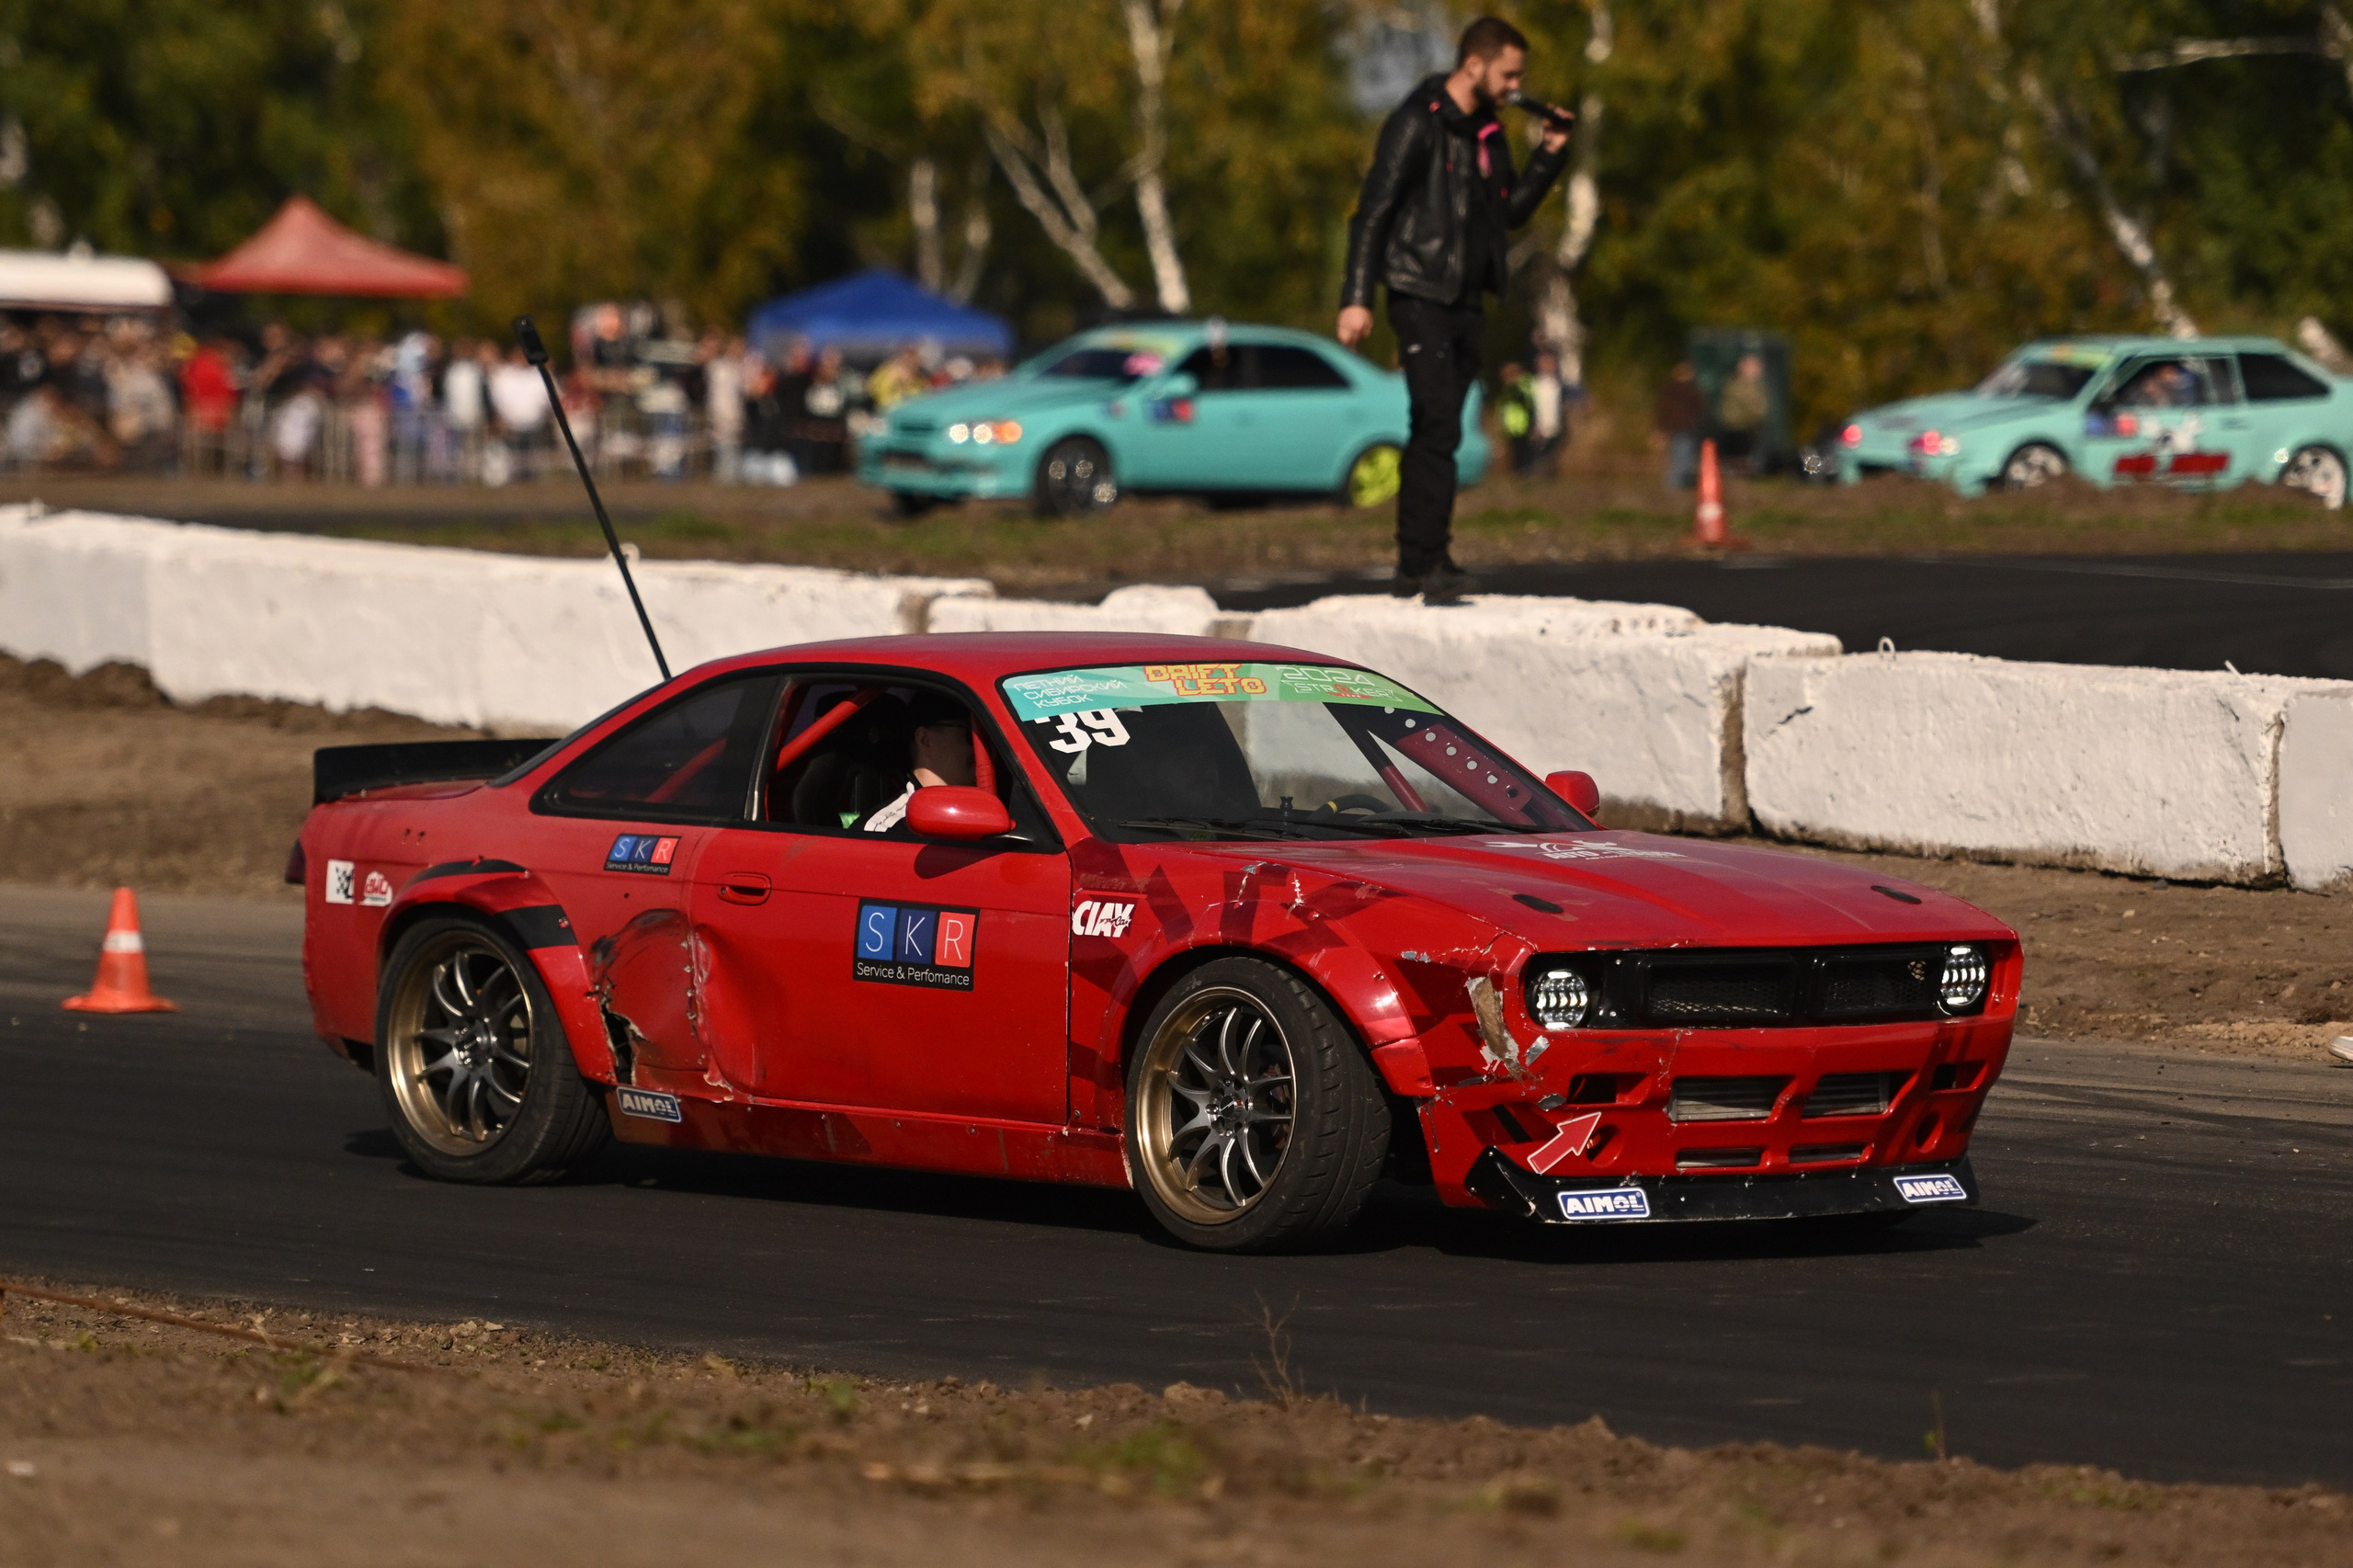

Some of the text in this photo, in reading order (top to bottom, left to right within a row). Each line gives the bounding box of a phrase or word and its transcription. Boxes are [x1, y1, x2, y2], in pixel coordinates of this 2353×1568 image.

[1143, 664, 1242, 682] DRIFT
[1276, 666, 1375, 687] 2024
[1013, 675, 1085, 691] ЛЕТНИЙ
[1023, 679, 1128, 699] СИБИРСКИЙ
[1174, 677, 1267, 696] LETO
[1033, 694, 1094, 709] КУБОК
[1034, 708, 1131, 754] 39
[614, 837, 672, 861] SKR
[606, 861, 627, 870] Service
[865, 912, 964, 960] SKR
[857, 961, 970, 986] Service & Perfomance
[622, 1093, 677, 1117] AIMOL
[1902, 1180, 1961, 1198] AIMOL
[1567, 1195, 1645, 1214] AIMOL
